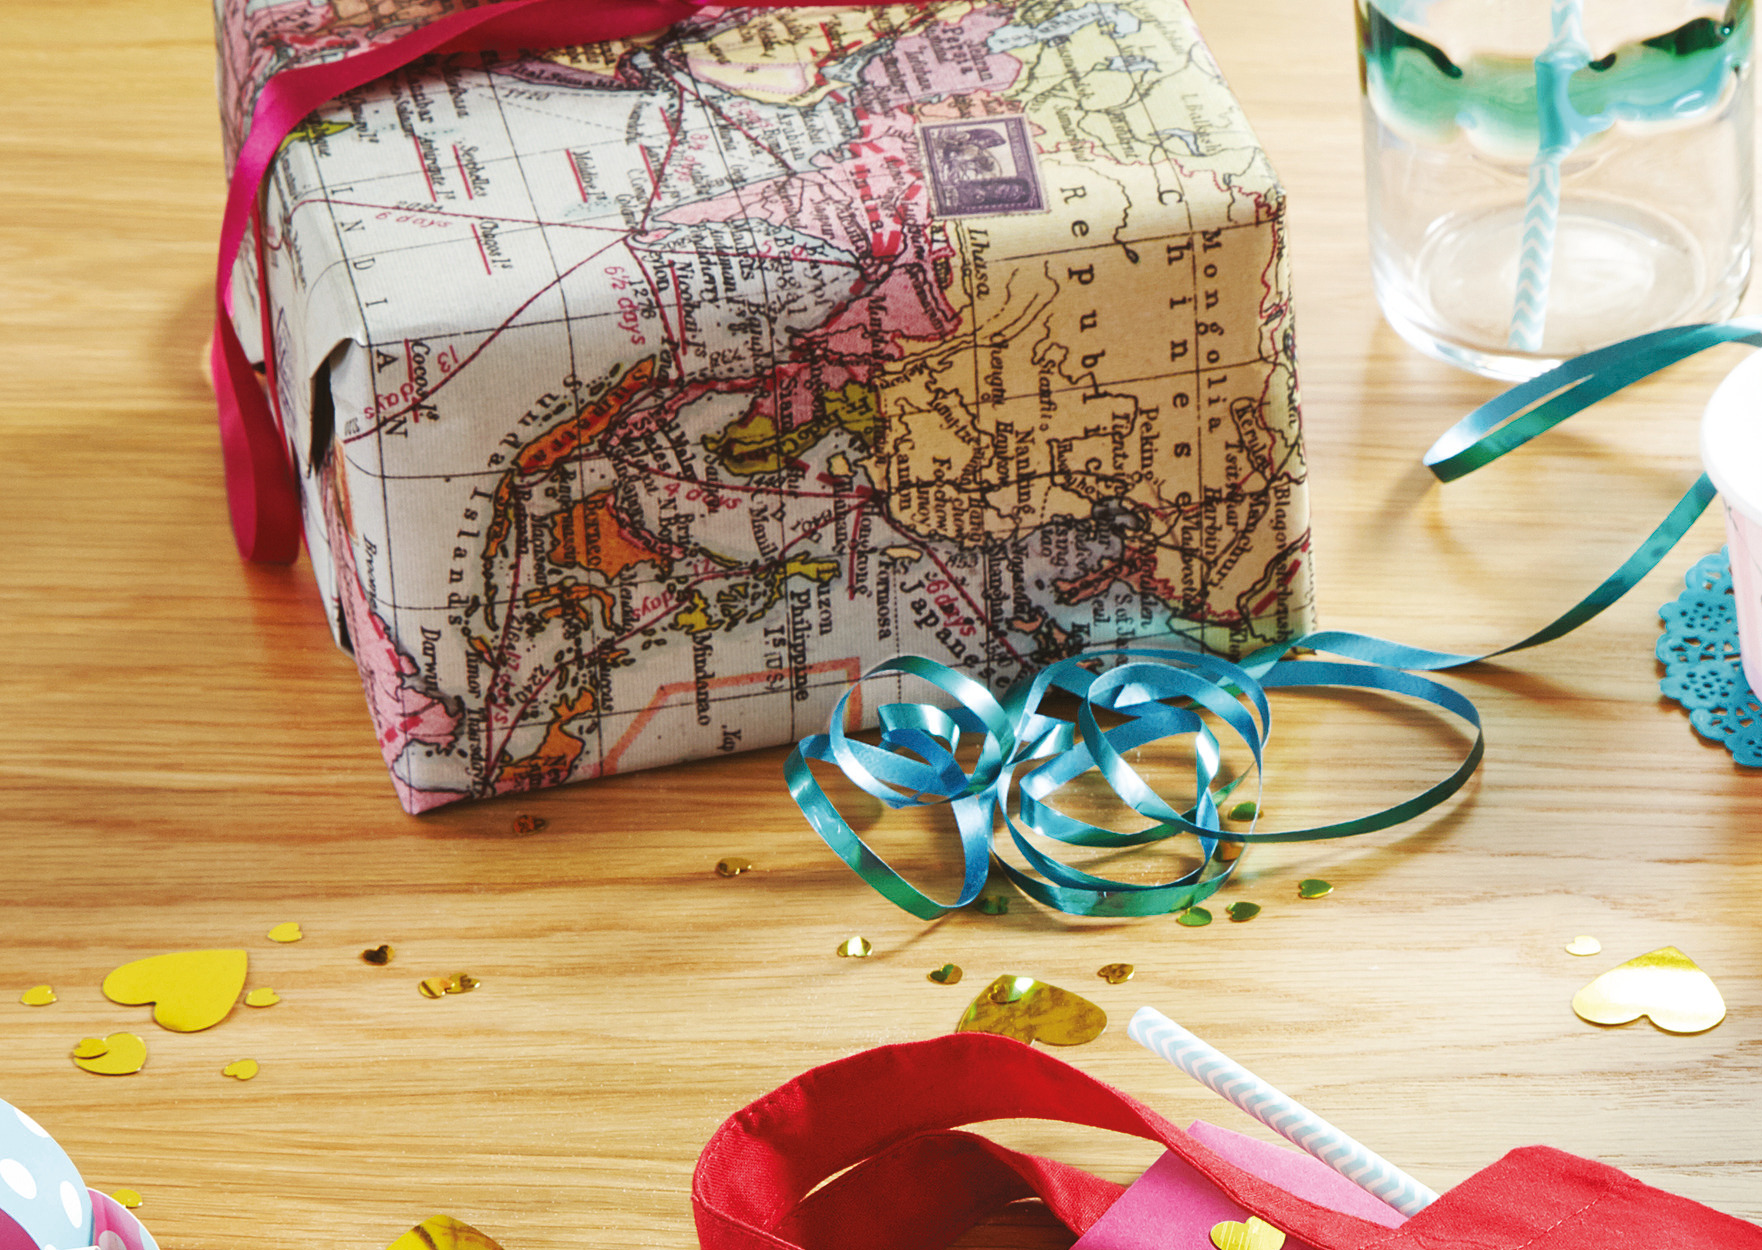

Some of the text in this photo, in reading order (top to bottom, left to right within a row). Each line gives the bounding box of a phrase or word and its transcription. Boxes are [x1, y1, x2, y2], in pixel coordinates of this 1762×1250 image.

[850, 169, 884, 233] India
[774, 235, 809, 315] Bengal
[968, 227, 991, 300] Lhasa
[618, 297, 646, 346] days
[1194, 228, 1228, 434] Mongolia
[410, 340, 432, 398] Cocos
[780, 377, 798, 432] Siam
[487, 374, 584, 469] Sunda
[1139, 405, 1161, 481] Peking
[1015, 425, 1037, 515] Nanking
[448, 486, 494, 627] Islands
[586, 501, 604, 568] Borneo
[1203, 484, 1223, 556] Harbin
[876, 559, 892, 641] Formosa
[421, 625, 442, 696] Darwin
[691, 632, 715, 727] Mindanao
[790, 588, 813, 702] Philippine
